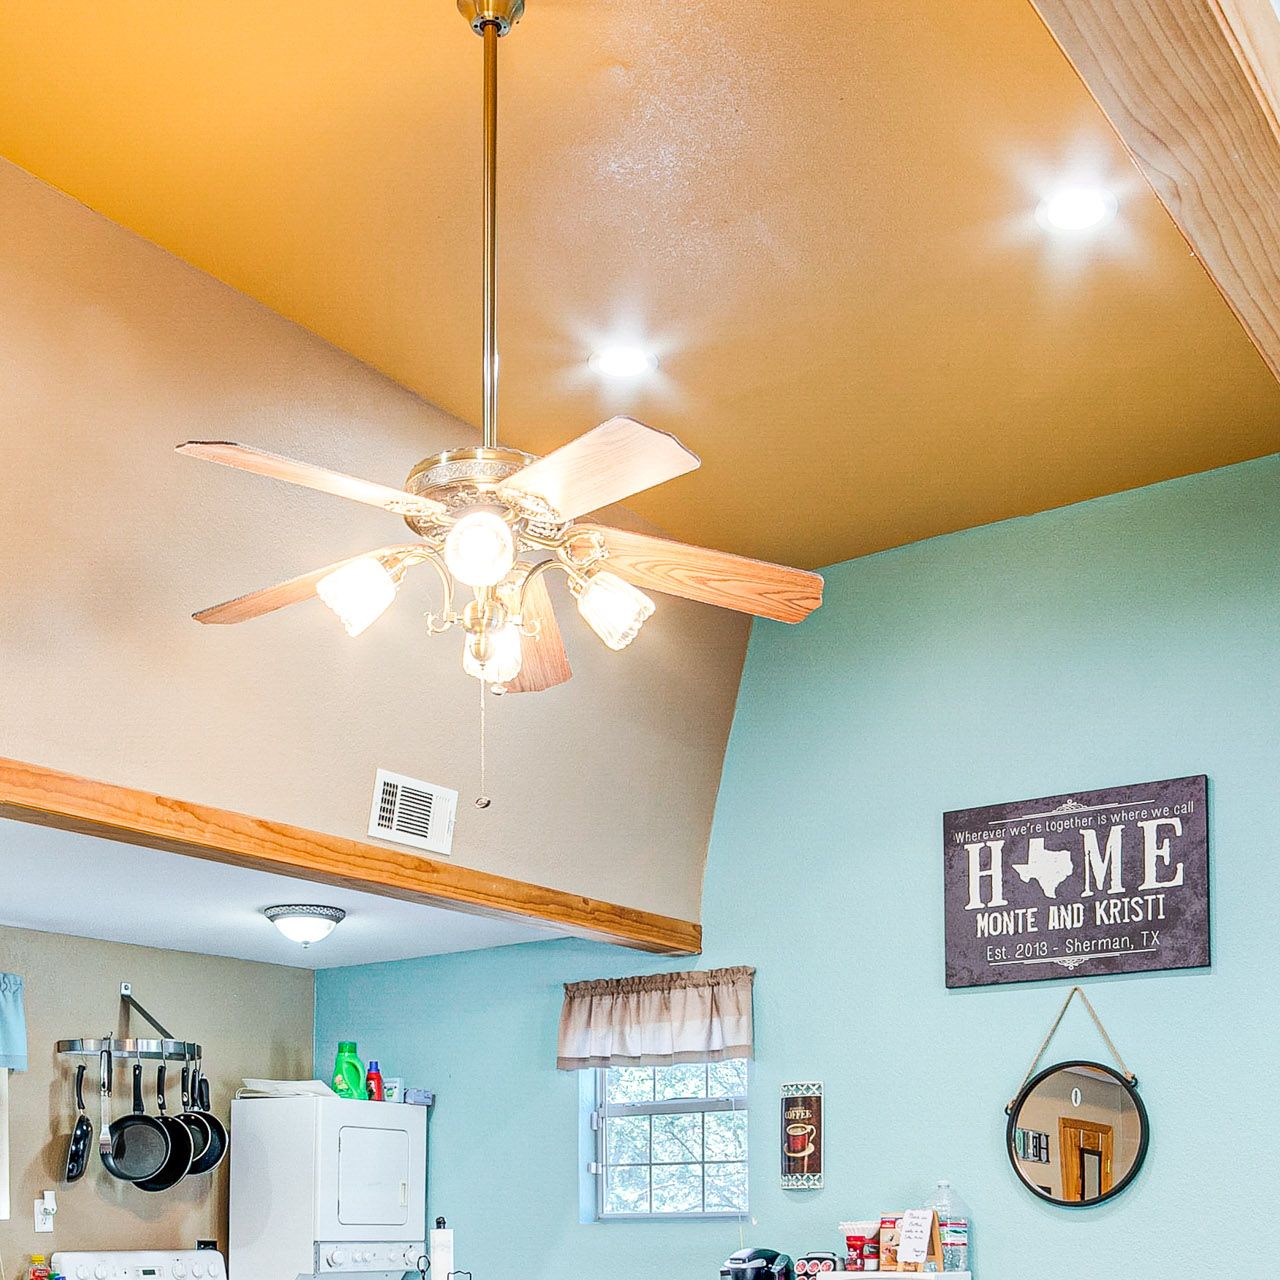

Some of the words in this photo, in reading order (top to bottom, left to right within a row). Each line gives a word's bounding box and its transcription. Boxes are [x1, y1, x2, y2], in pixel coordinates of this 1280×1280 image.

[955, 828, 1006, 843] Wherever
[1010, 822, 1042, 836] we're
[1045, 814, 1093, 833] together
[1097, 813, 1107, 825] is
[1110, 809, 1148, 823] where
[1151, 806, 1170, 818] we
[1173, 800, 1194, 815] call
[976, 907, 1038, 938] MONTE
[1048, 903, 1084, 930] AND
[1095, 894, 1166, 926] KRISTI
[987, 946, 1011, 961] Est.
[1015, 942, 1048, 958] 2013
[1065, 935, 1135, 954] Sherman,
[1141, 930, 1161, 946] TX
